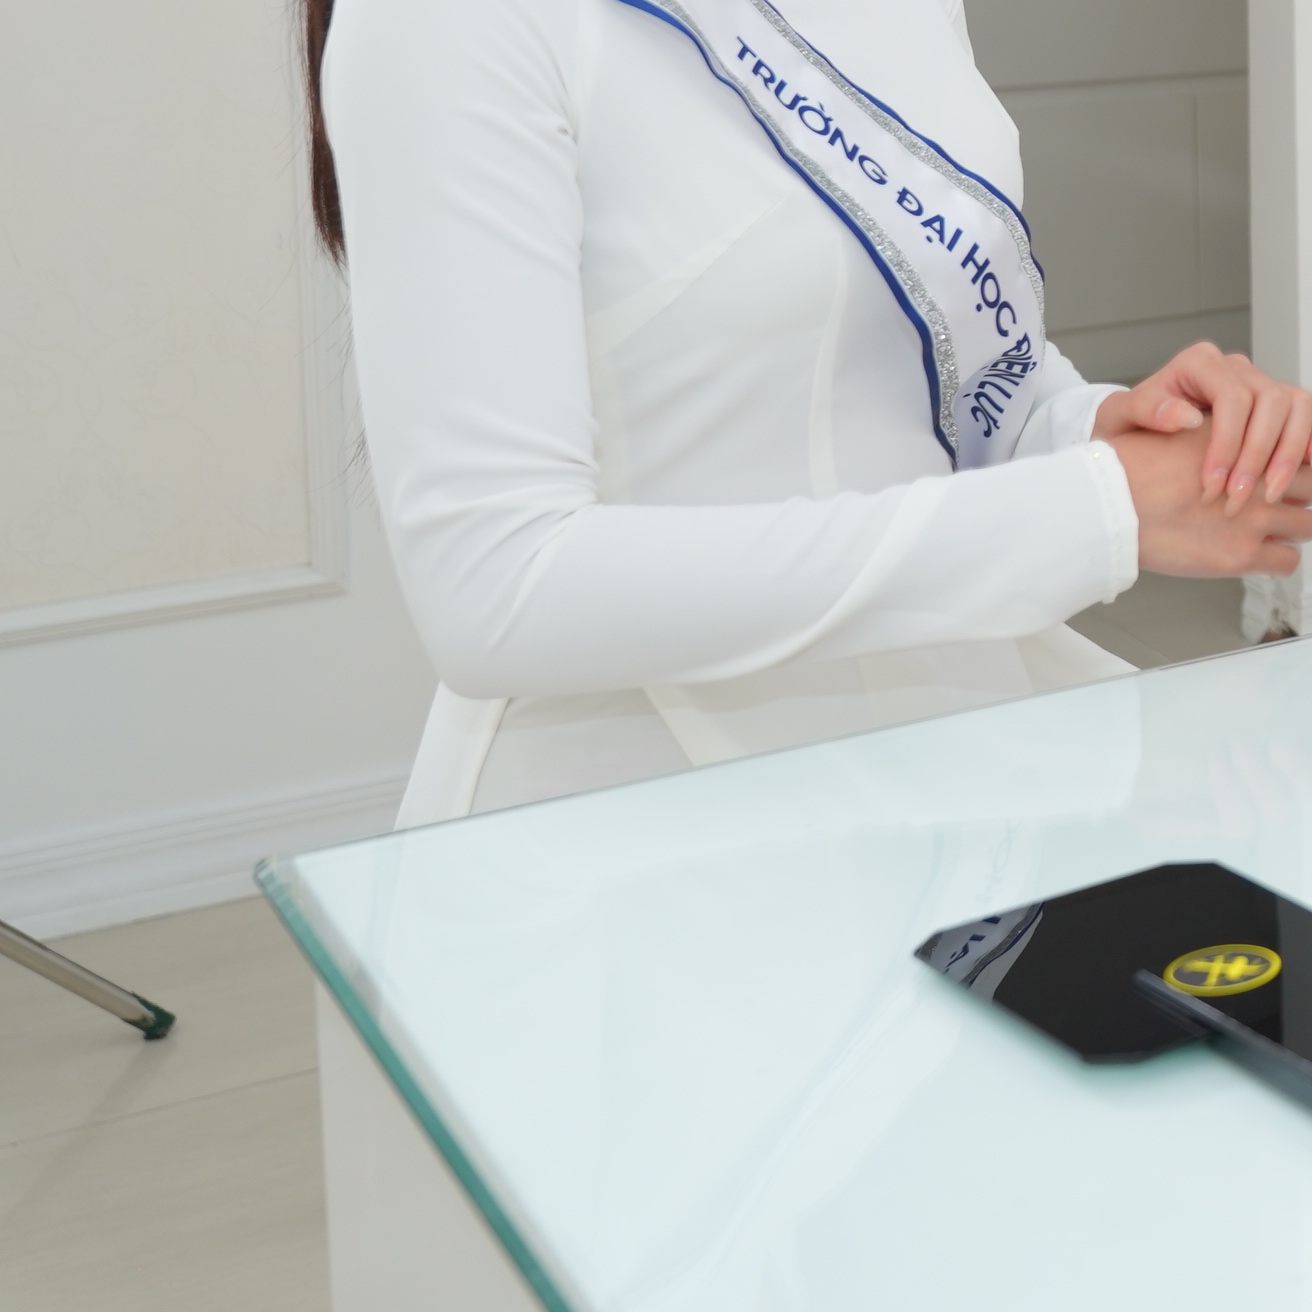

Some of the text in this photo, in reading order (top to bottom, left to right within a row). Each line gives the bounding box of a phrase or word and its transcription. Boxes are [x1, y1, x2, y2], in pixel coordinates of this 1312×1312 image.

[736, 35, 888, 186] TRƯỜNG
[897, 187, 964, 253] ĐẠI
[960, 242, 1017, 338] HỌC
[962, 380, 1013, 439] LỰC
